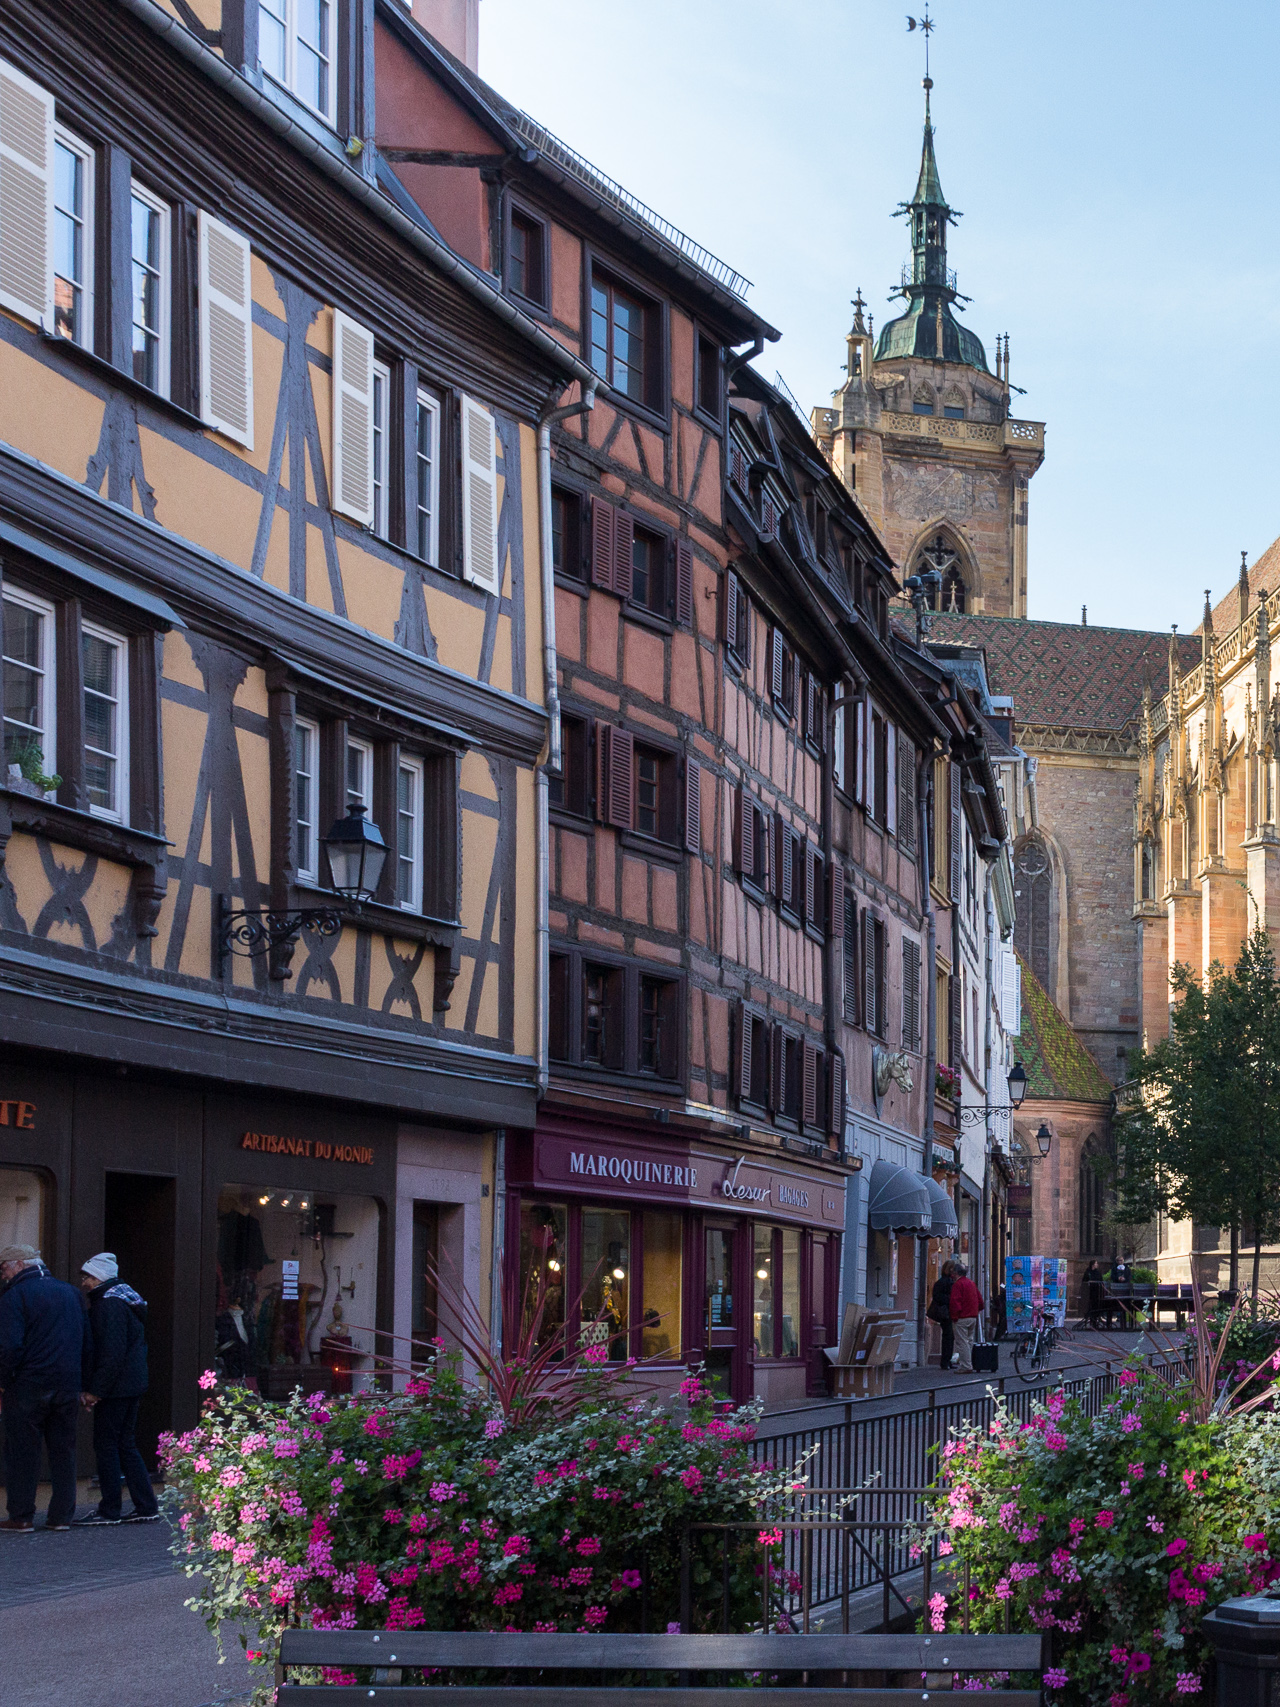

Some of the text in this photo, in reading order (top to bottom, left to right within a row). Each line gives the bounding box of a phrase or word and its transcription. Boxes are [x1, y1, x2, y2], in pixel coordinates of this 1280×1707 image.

[242, 1131, 375, 1165] ARTISANAT DU MONDE
[569, 1151, 698, 1188] MAROQUINERIE
[722, 1155, 771, 1202] Lesur
[778, 1184, 809, 1208] BAGAGES
